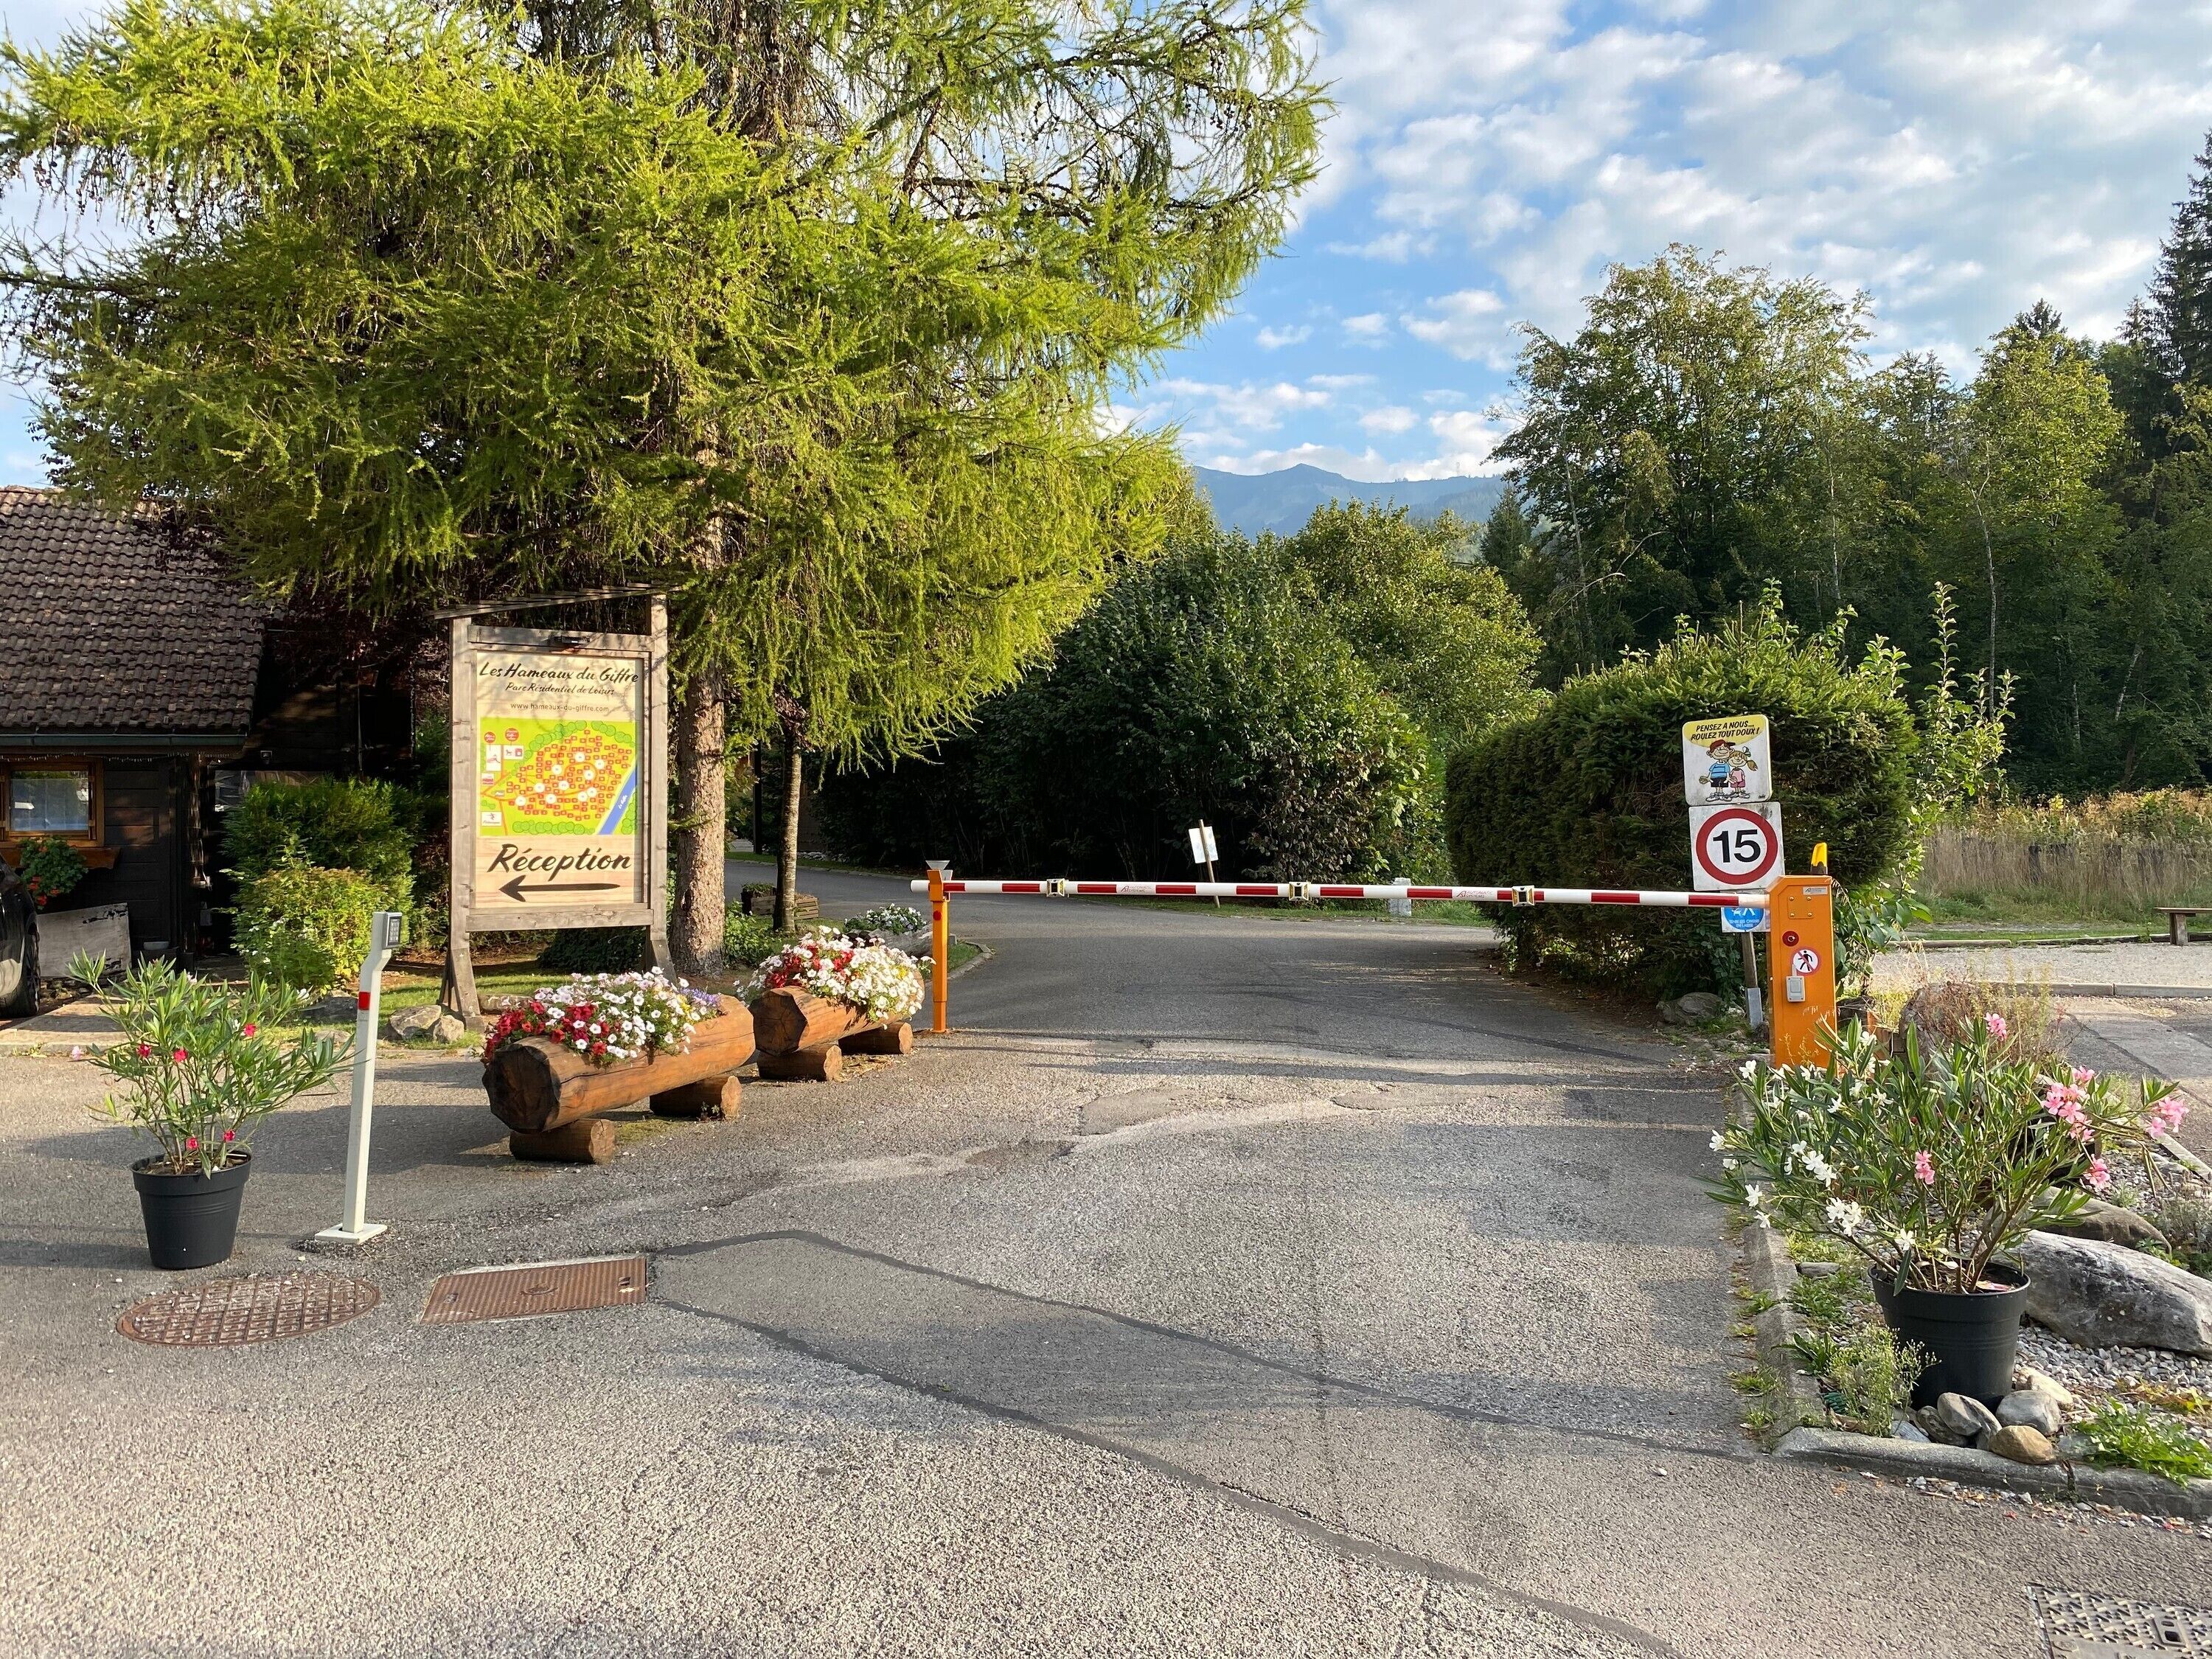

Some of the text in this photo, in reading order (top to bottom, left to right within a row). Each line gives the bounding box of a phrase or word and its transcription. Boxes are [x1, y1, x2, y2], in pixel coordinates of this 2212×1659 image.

[479, 661, 639, 684] Les Hameaux du Giffre
[505, 682, 614, 695] Parc Résidentiel de Loisirs
[510, 703, 609, 712] www.hameaux-du-giffre.com
[1696, 723, 1721, 732] PENSEZ
[1691, 732, 1717, 740] ROULEZ
[1713, 829, 1761, 863] 15
[487, 844, 632, 882] Réception
